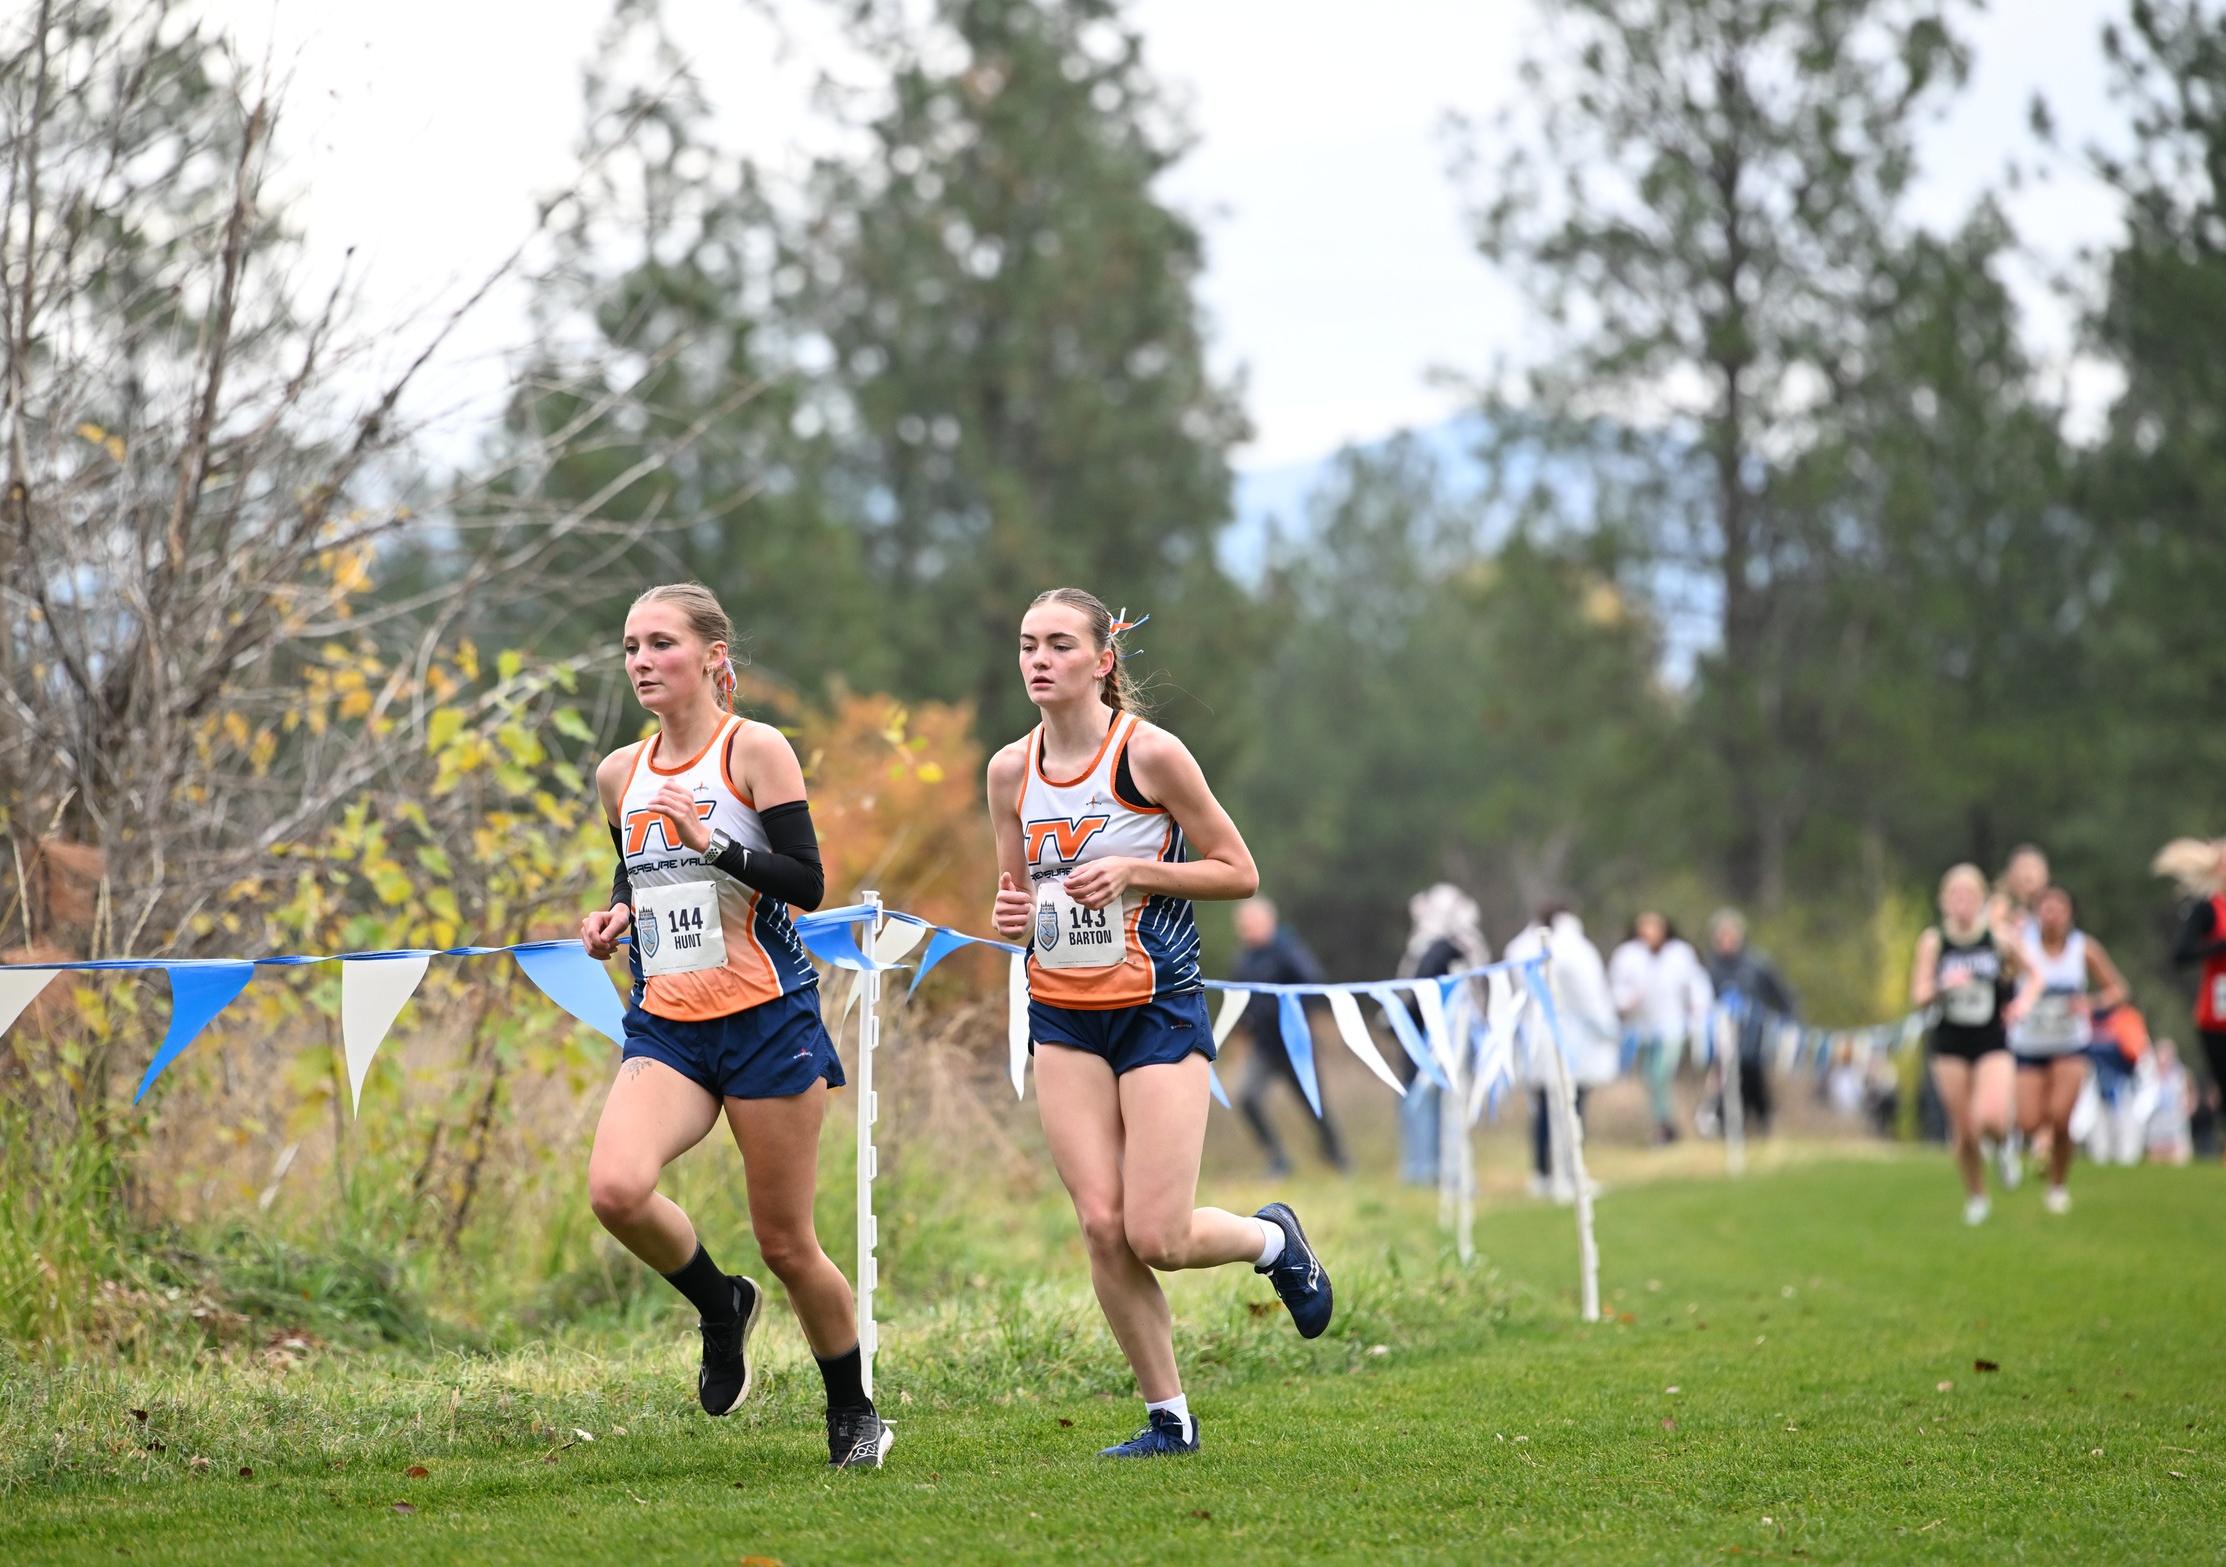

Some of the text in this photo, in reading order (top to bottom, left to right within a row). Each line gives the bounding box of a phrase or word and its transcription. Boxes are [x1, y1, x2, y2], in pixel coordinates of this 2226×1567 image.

[1025, 815, 1110, 866] TV
[668, 907, 704, 933] 144
[1070, 906, 1106, 928] 143
[674, 933, 702, 950] HUNT
[1069, 930, 1112, 946] BARTON
